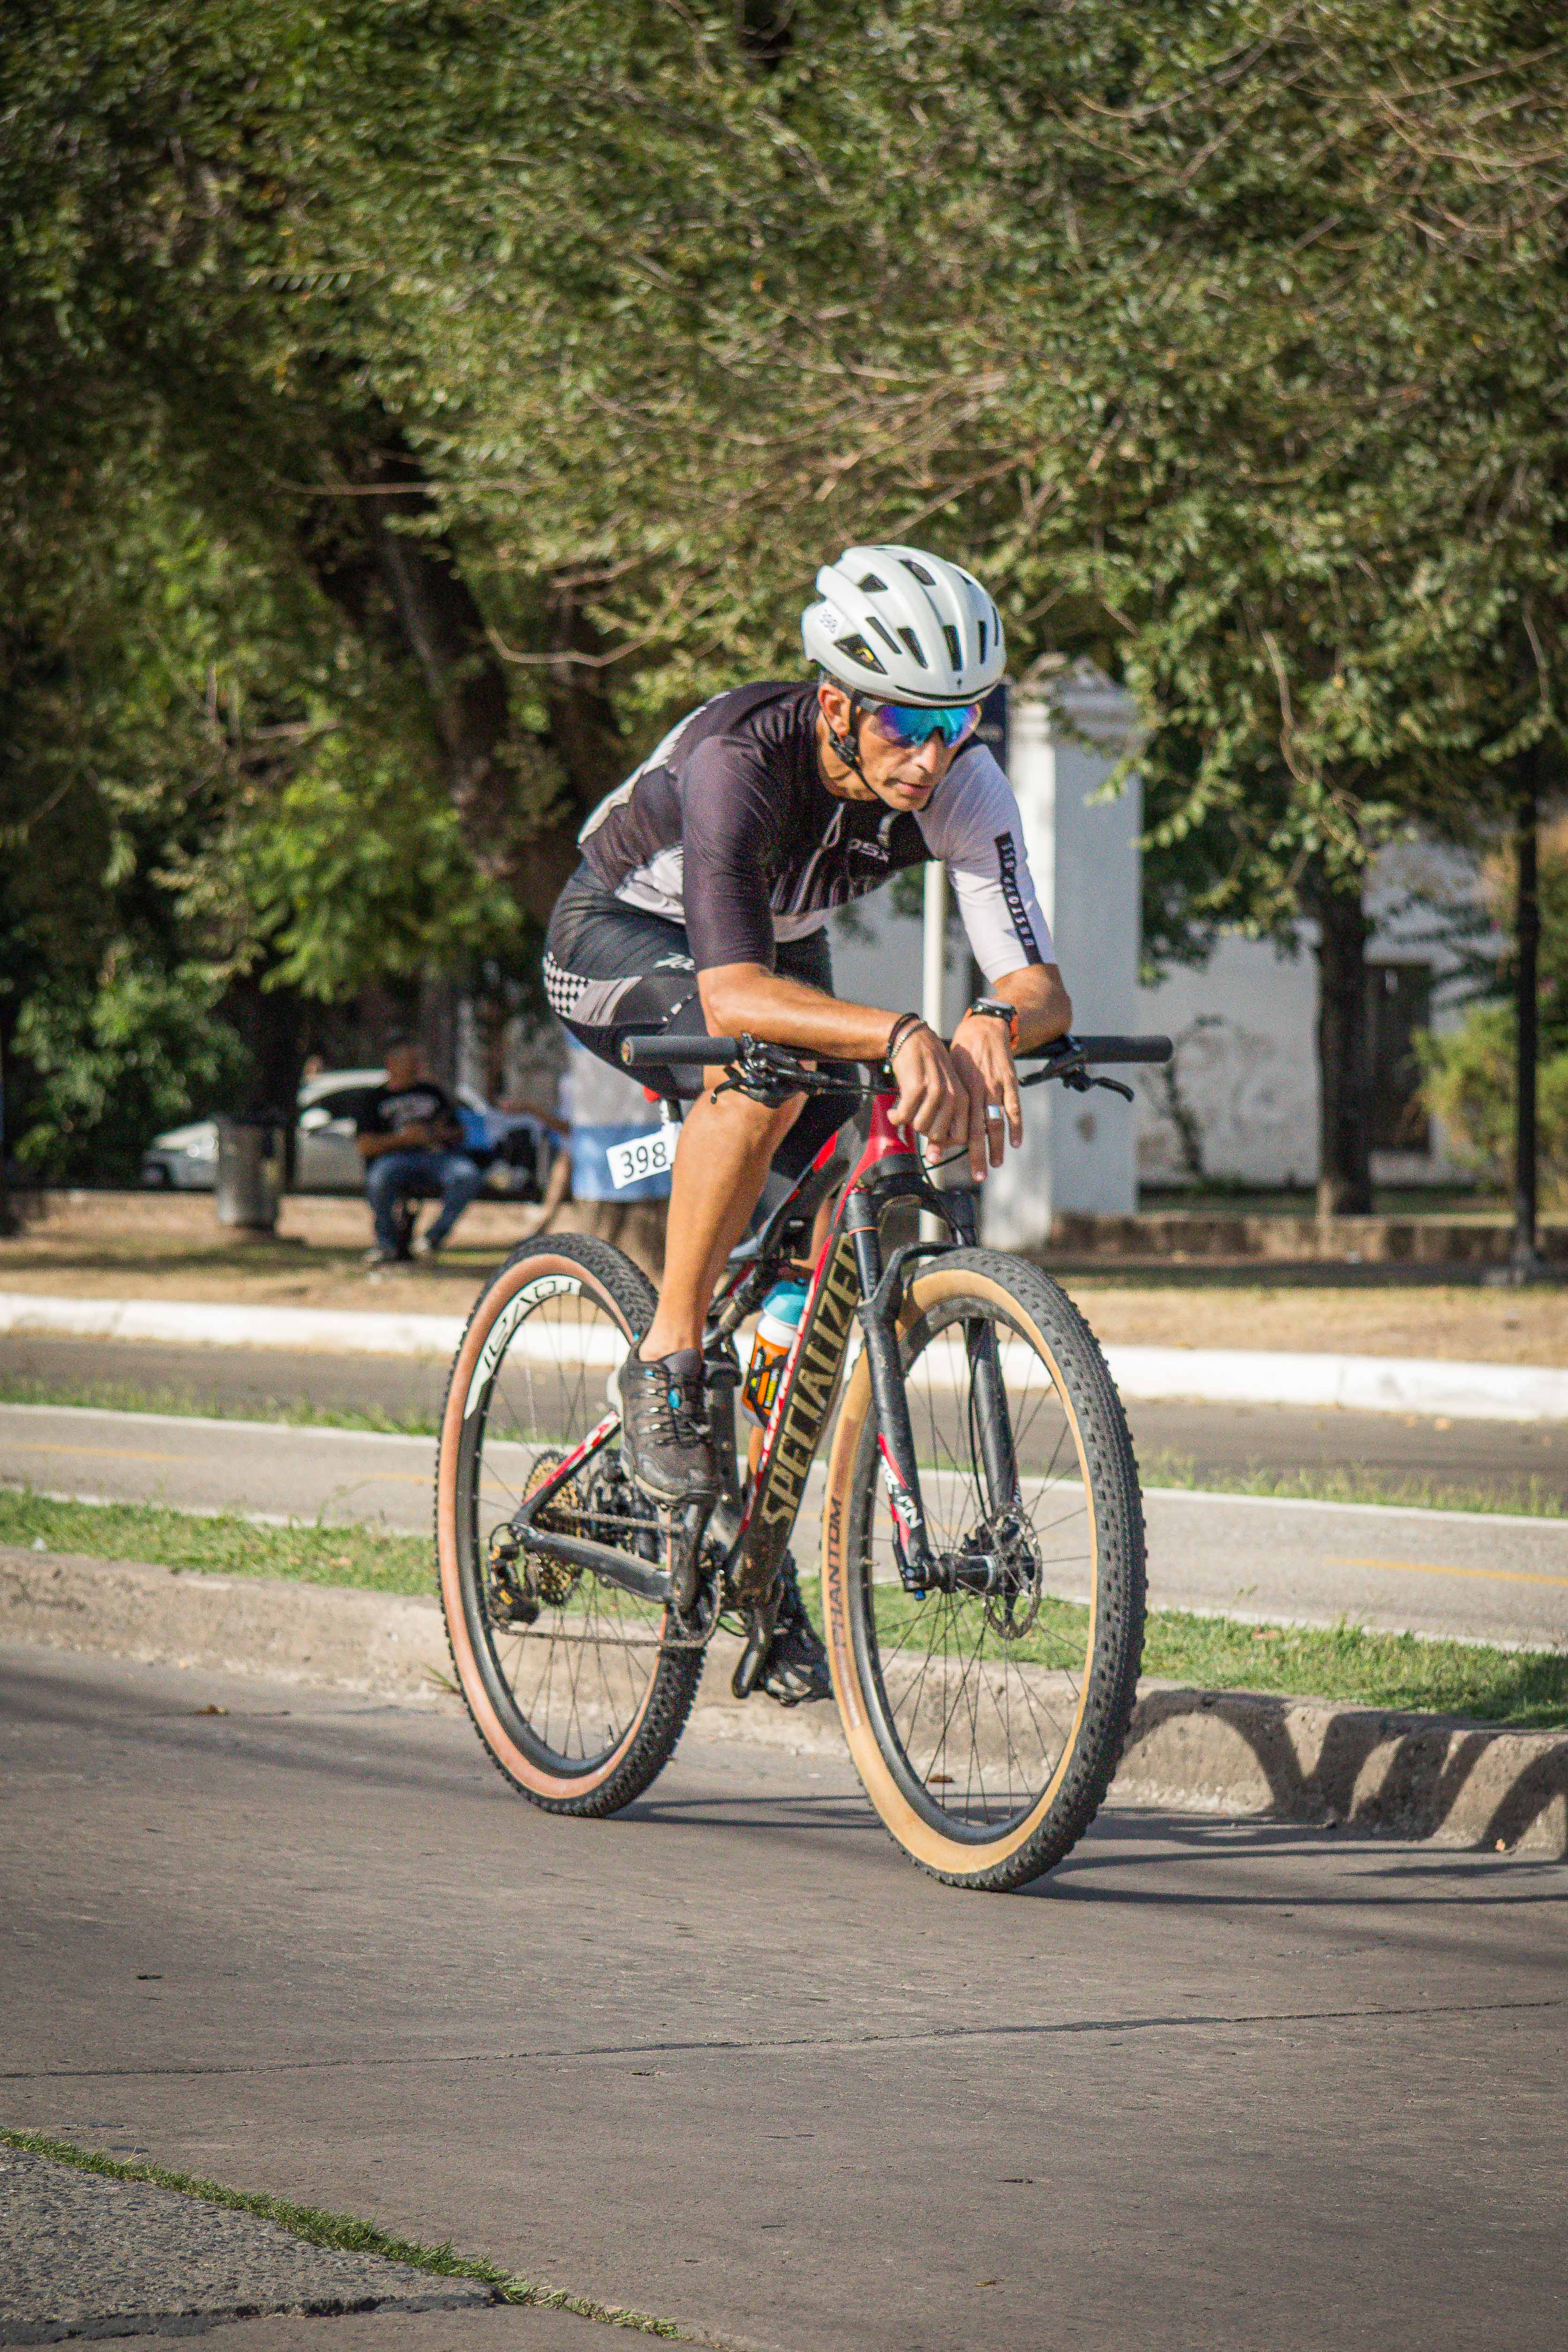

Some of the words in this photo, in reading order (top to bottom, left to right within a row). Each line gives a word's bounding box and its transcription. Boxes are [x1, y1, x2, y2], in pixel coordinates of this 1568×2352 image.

[1001, 842, 1035, 946] UNSTOPPBLE
[620, 1141, 667, 1178] 398
[828, 1496, 847, 1648] PHANTOM
